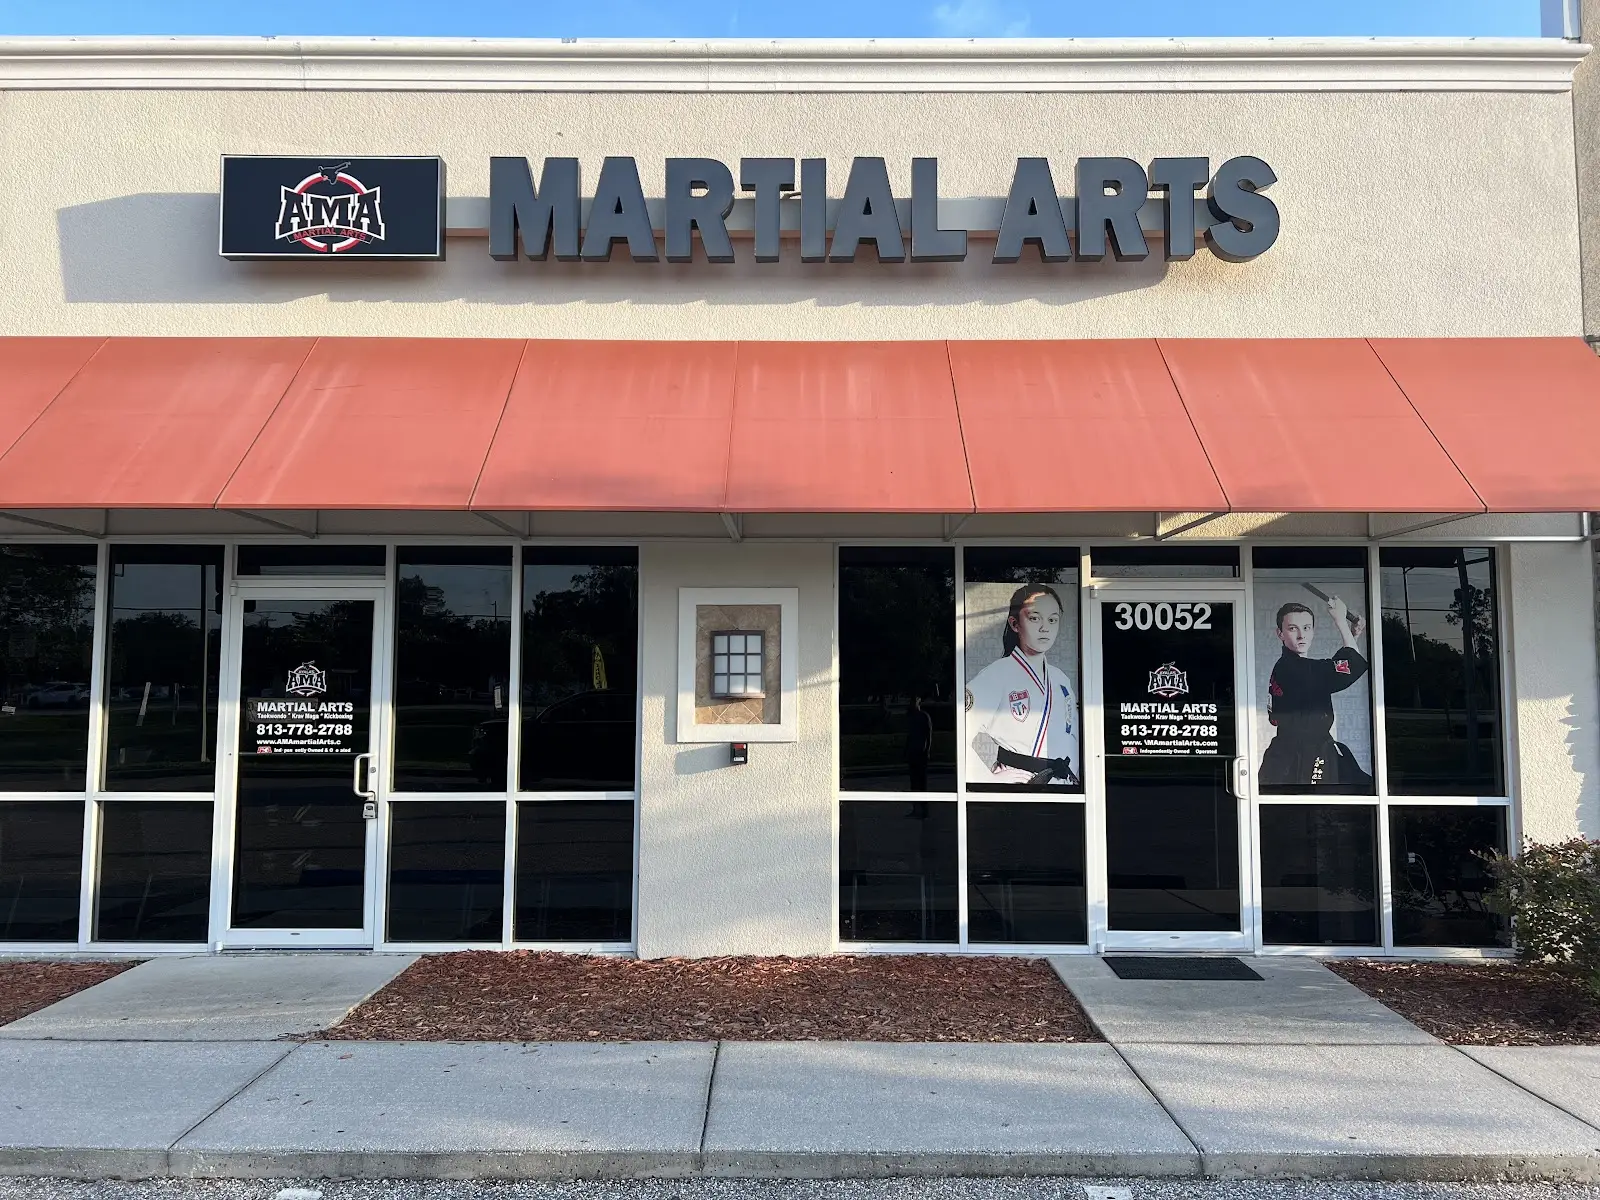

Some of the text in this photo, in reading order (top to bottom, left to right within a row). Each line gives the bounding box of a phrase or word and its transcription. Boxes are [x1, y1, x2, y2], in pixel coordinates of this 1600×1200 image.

[275, 186, 385, 240] AMA
[488, 155, 1281, 264] MARTIAL ARTS
[293, 227, 367, 240] MARTIAL ARTS
[1114, 602, 1212, 631] 30052
[286, 670, 327, 692] AMA
[1148, 671, 1189, 693] AMA
[257, 702, 353, 712] MARTIAL ARTS
[1120, 702, 1218, 713] MARTIAL ARTS
[256, 723, 353, 736] 813-778-2788
[1120, 724, 1218, 737] 813-778-2788
